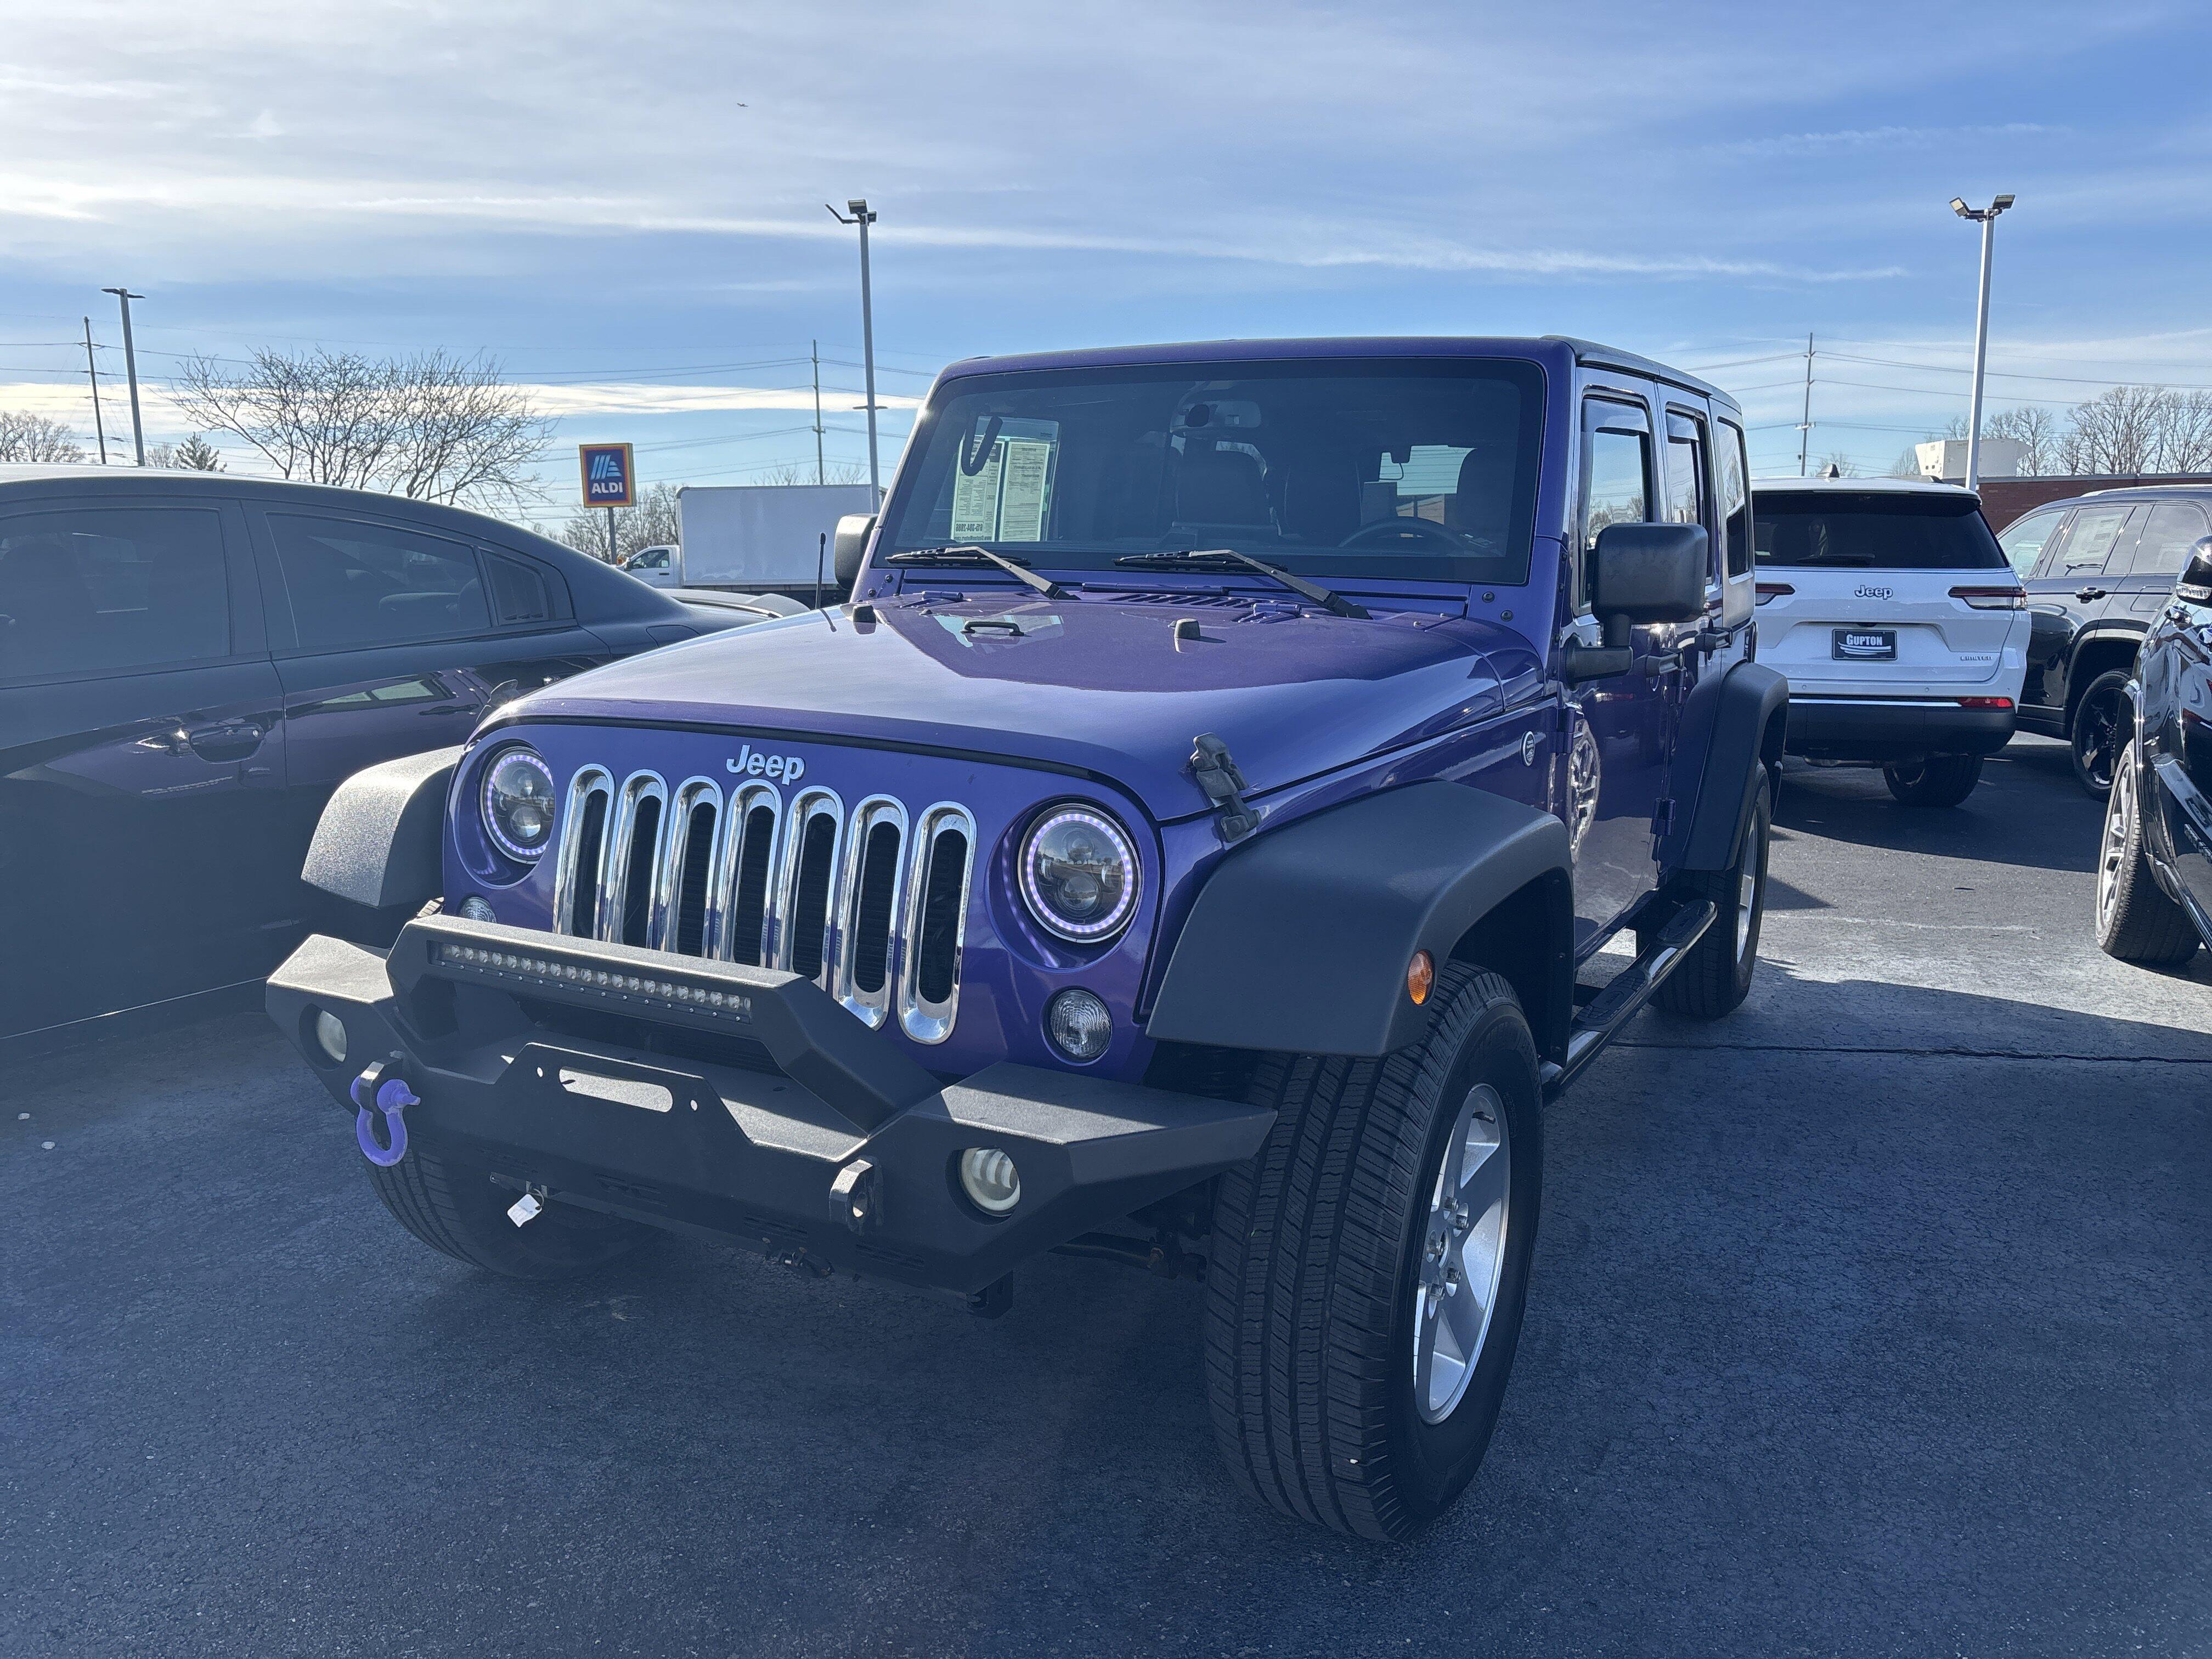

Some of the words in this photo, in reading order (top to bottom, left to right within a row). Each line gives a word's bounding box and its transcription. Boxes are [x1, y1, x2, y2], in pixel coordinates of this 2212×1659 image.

[591, 482, 623, 494] ALDI
[1854, 585, 1893, 600] Jeep
[1846, 634, 1883, 646] GUPTON
[726, 744, 805, 786] Jeep
